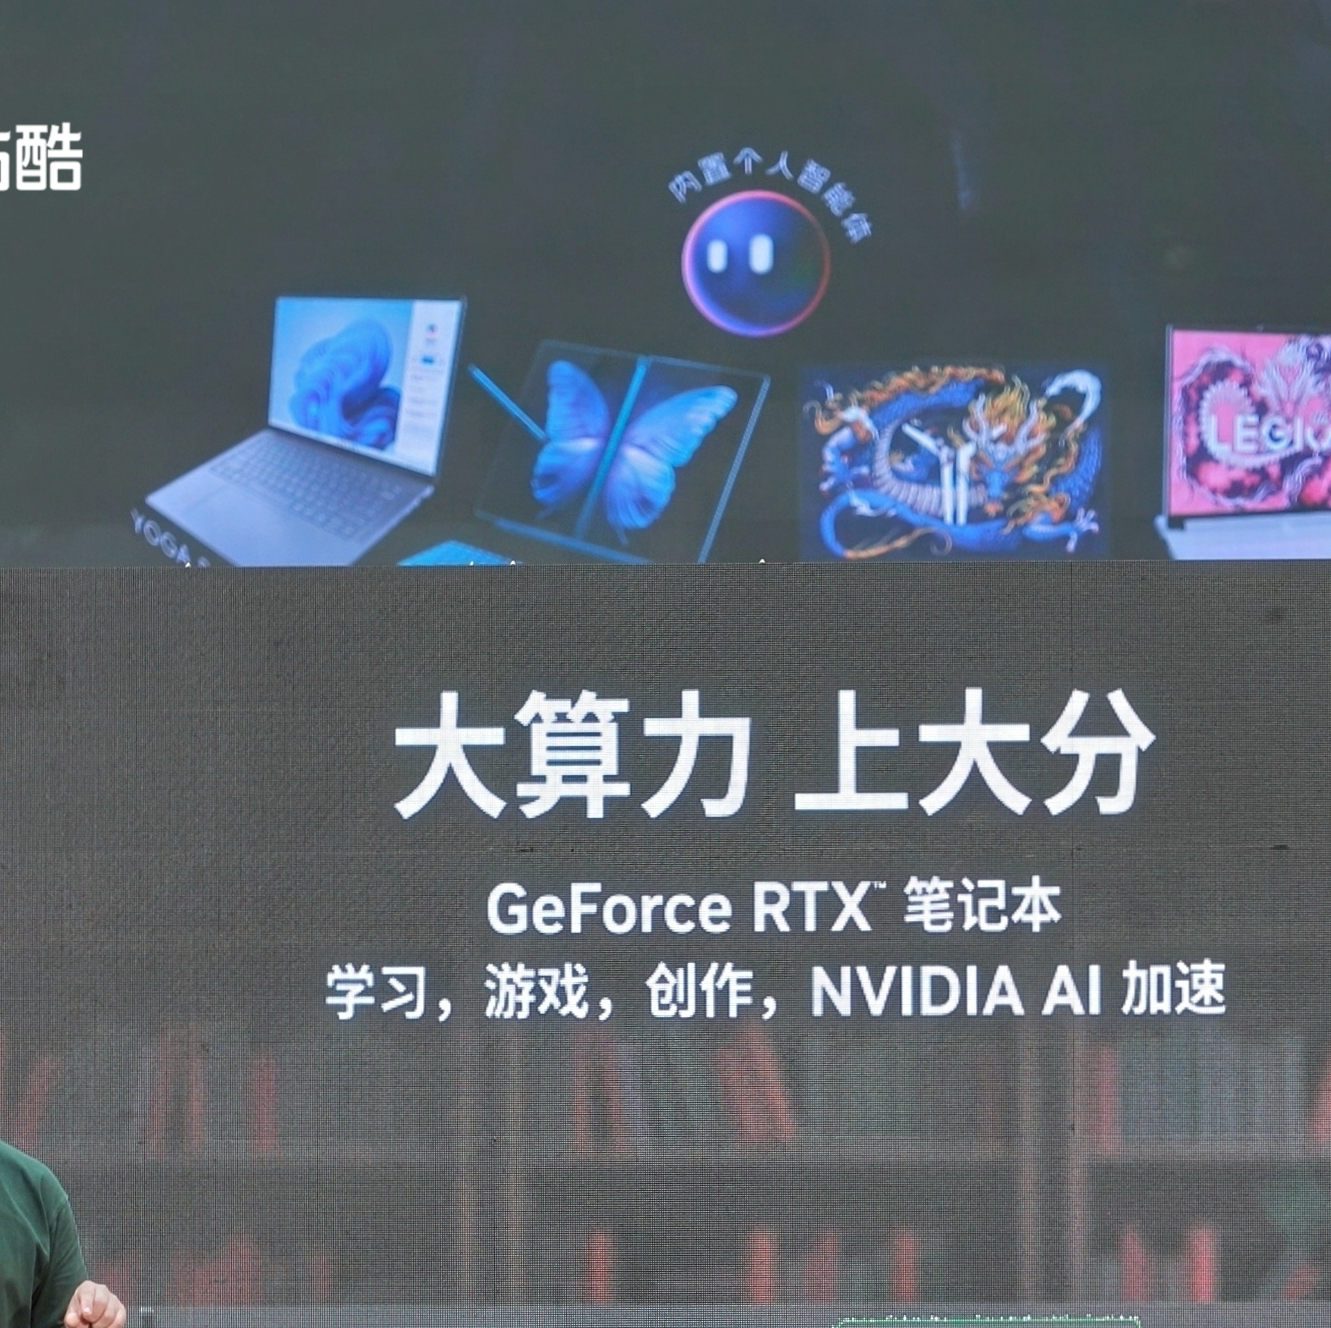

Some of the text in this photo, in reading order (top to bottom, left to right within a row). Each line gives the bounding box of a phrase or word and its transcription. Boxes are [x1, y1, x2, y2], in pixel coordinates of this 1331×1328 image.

[668, 147, 873, 244] 内置个人智能体
[393, 687, 1156, 820] 大算力 上大分
[487, 882, 732, 936] GeForce
[904, 877, 1061, 934] 笔记本
[1041, 966, 1101, 1016] AI
[1120, 960, 1228, 1018] 加速
